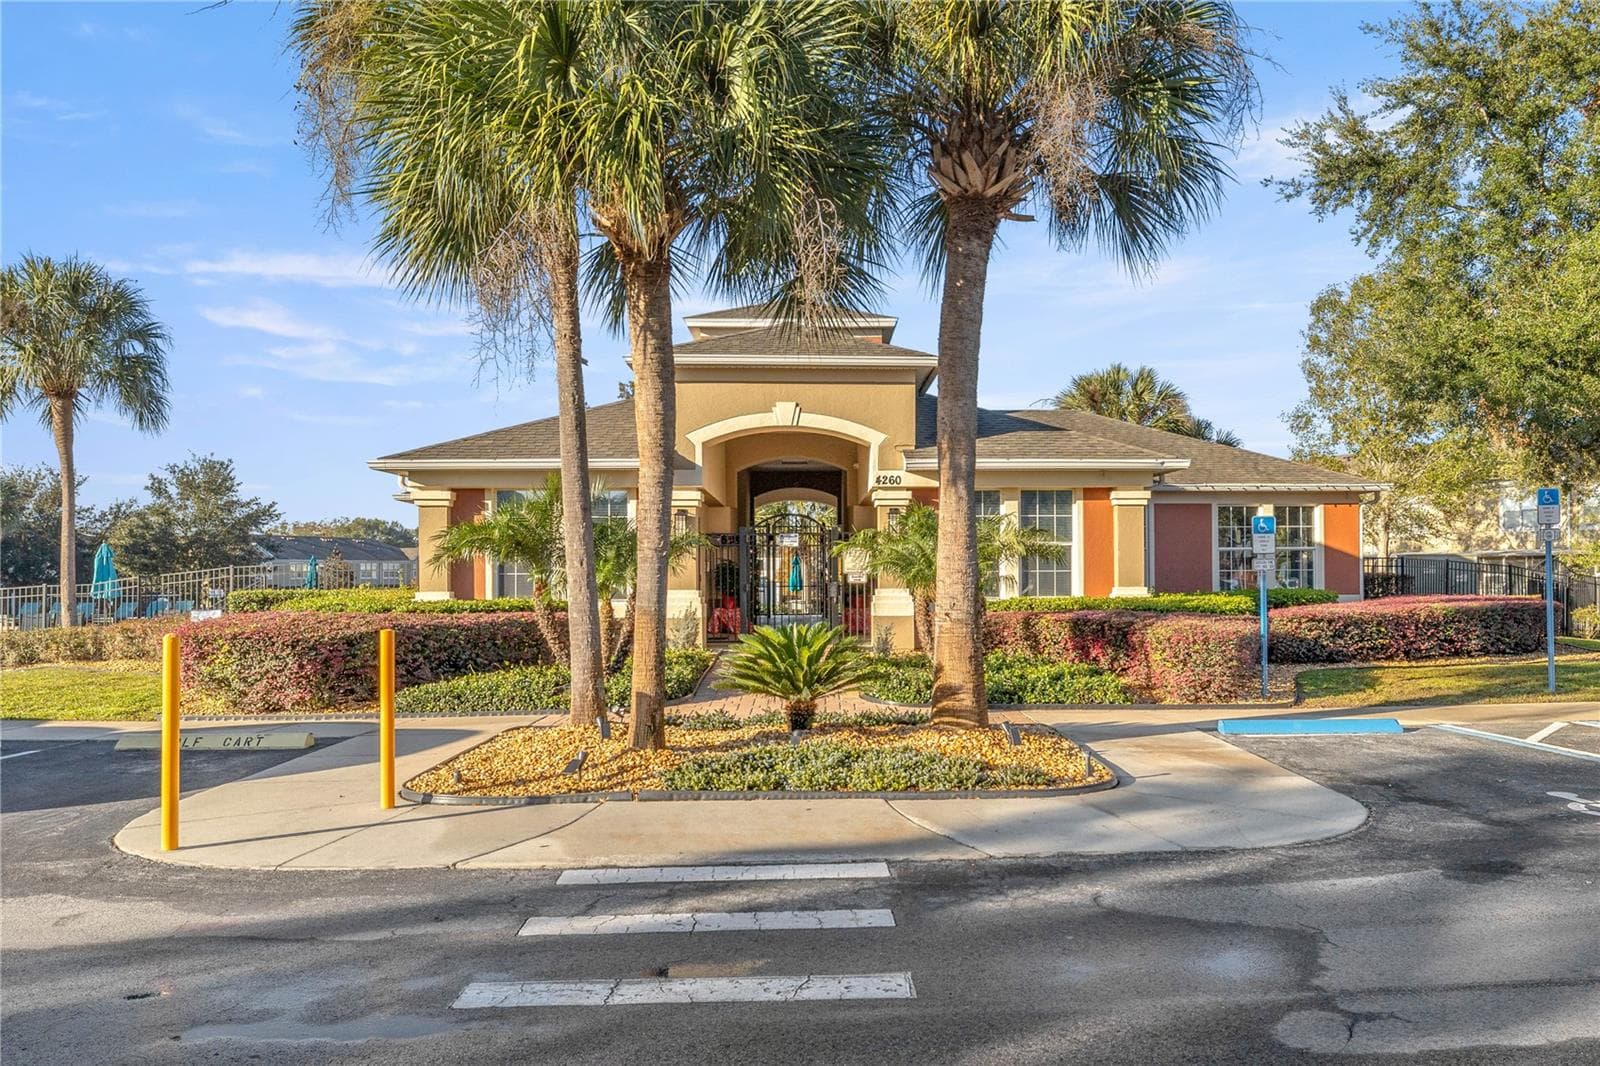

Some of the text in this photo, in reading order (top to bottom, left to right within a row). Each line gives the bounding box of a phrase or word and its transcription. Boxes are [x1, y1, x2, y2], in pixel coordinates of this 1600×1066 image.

[875, 475, 902, 485] 4260
[179, 736, 265, 748] LF CART
